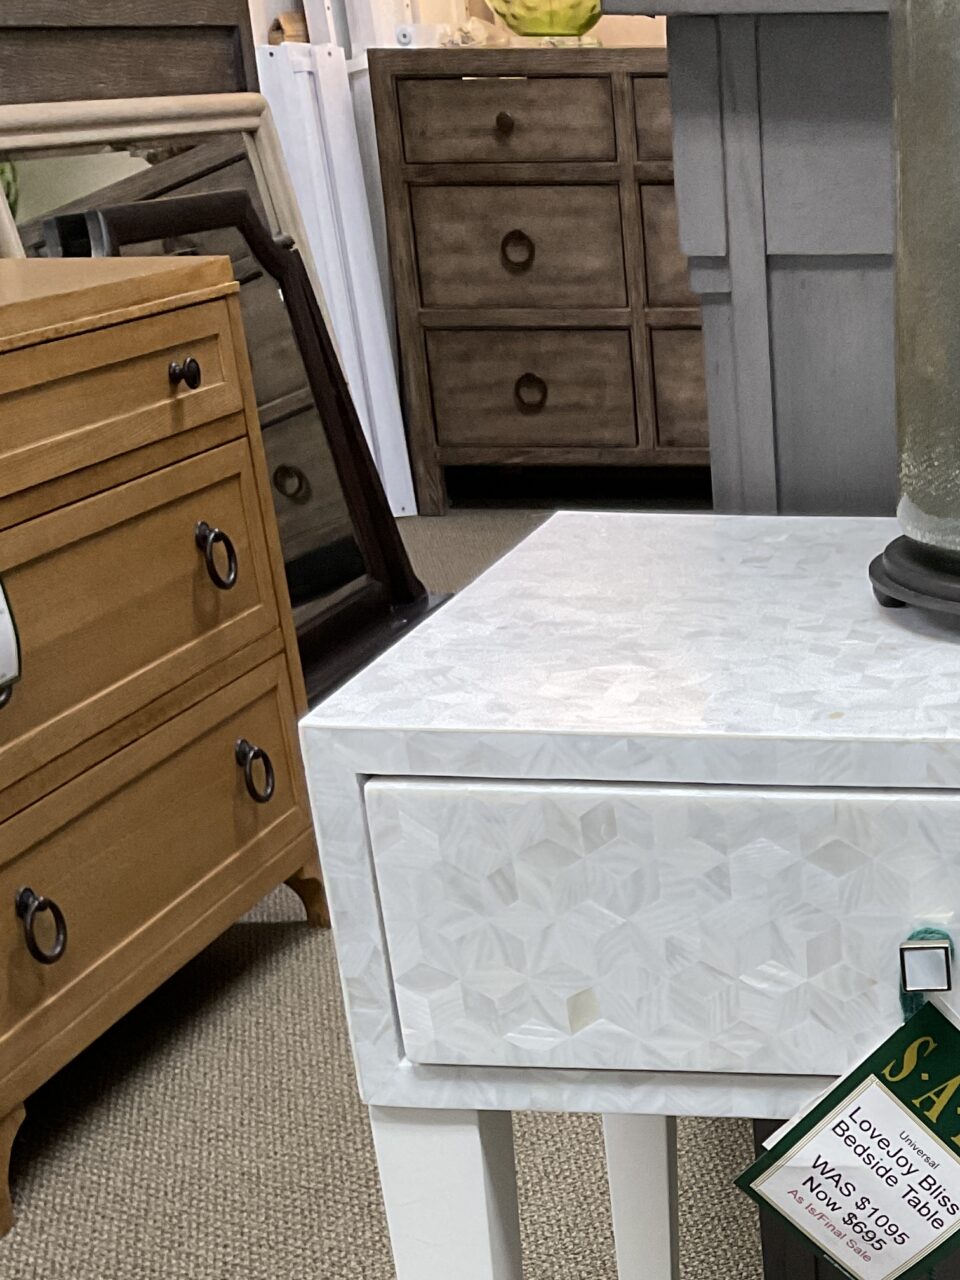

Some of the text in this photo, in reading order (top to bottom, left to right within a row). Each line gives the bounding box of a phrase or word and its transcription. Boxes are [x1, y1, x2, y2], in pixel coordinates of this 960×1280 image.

[831, 1119, 944, 1230] Bedside Table
[848, 1106, 960, 1216] LoveJoy Bliss
[899, 1130, 940, 1170] Universal
[787, 1188, 872, 1263] As Is/Final Sale
[801, 1176, 888, 1251] Now $695
[811, 1154, 910, 1245] WAS $1095
